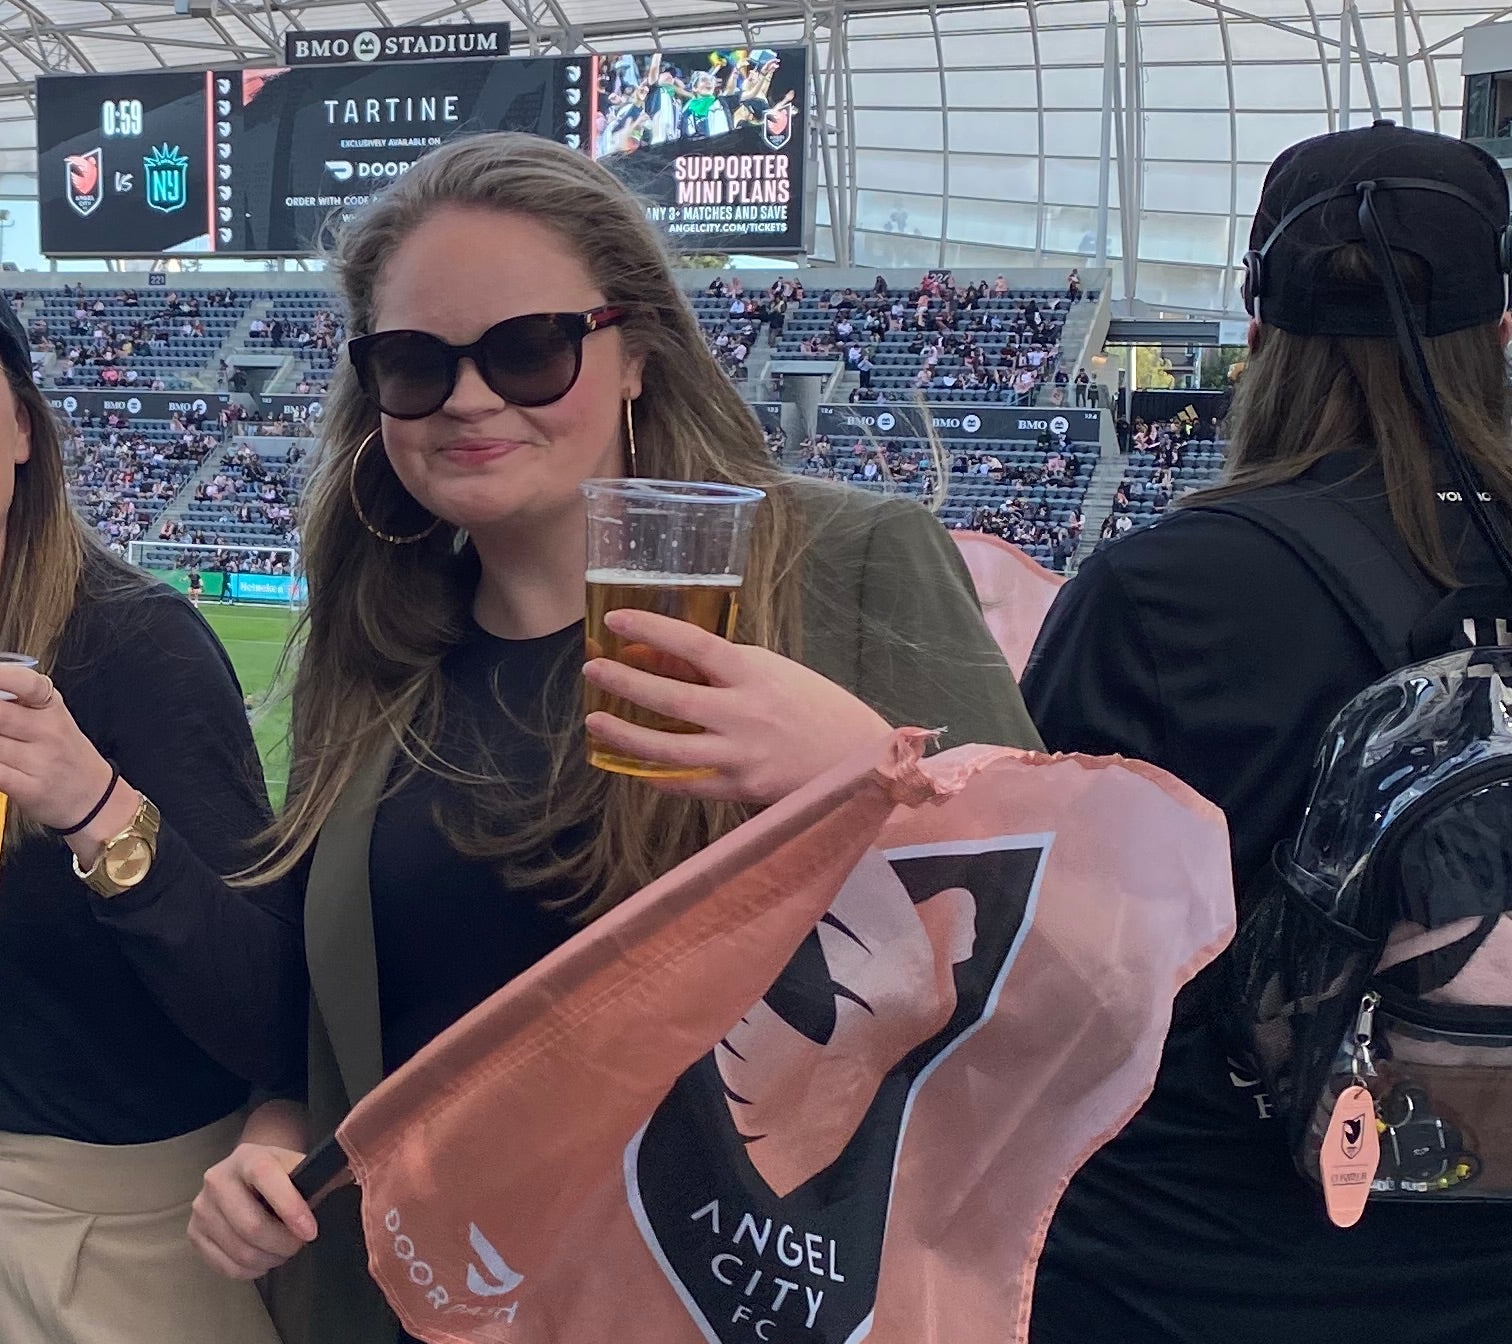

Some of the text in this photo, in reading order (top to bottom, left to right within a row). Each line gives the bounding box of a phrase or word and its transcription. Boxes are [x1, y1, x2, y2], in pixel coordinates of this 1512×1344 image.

[295, 33, 498, 57] BMO STADIUM
[103, 100, 143, 135] 0:59
[324, 96, 459, 123] TARTINE
[341, 137, 441, 148] EXCLUSIVELY AVAILABLE ON
[359, 161, 417, 177] DOOR
[675, 155, 789, 181] SUPPORTER
[153, 170, 179, 201] NY
[678, 180, 790, 204] MINI PLANS
[286, 197, 315, 206] ORDER
[318, 196, 341, 206] WITH
[645, 207, 666, 220] ANY
[683, 207, 732, 220] MATCHES
[735, 206, 758, 220] AND
[760, 206, 788, 219] SAVE
[669, 222, 788, 234] ANGELCITY.COM/TICKETS
[104, 401, 125, 410] BMO
[168, 402, 191, 413] BMO
[847, 416, 876, 426] BMO
[1018, 419, 1048, 431] BMO
[240, 582, 283, 593] Heineken
[691, 1199, 845, 1283] ANGEL
[710, 1253, 824, 1330] CITY
[731, 1305, 777, 1342] FC
